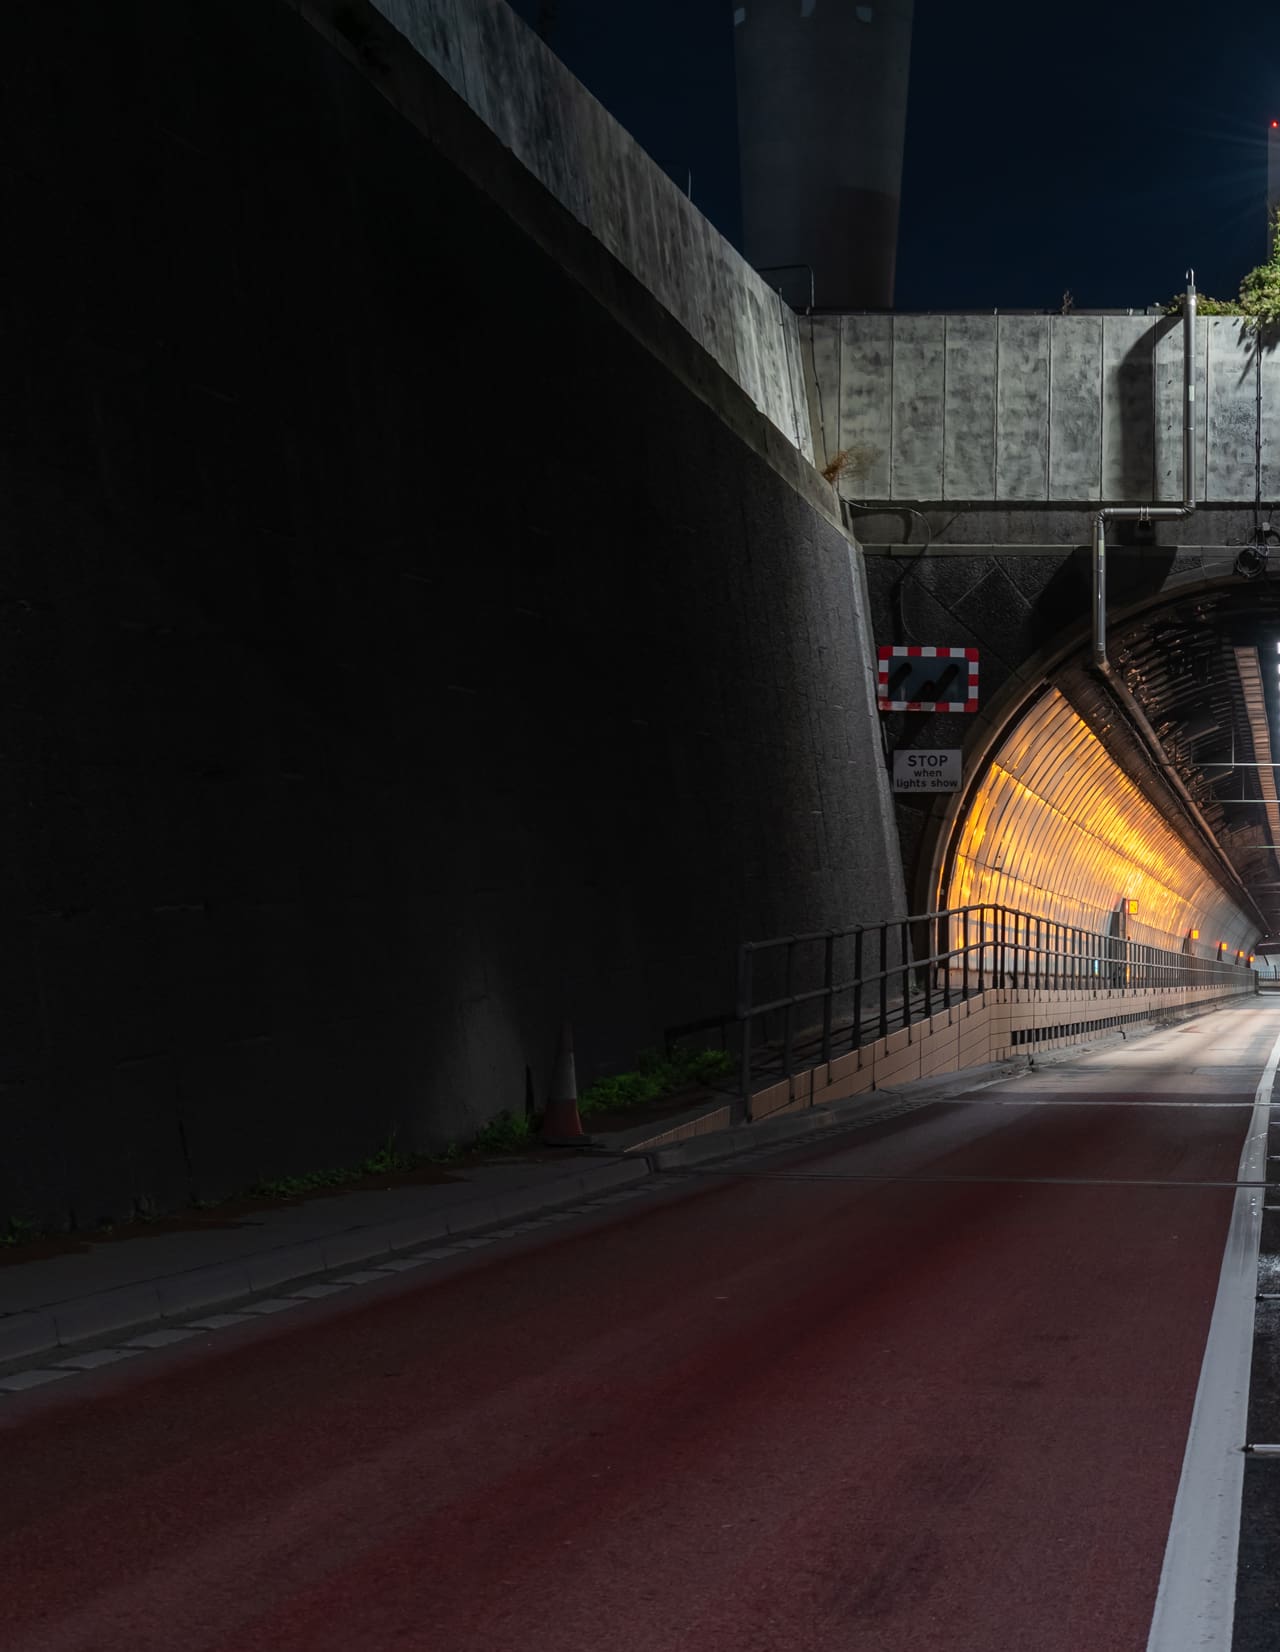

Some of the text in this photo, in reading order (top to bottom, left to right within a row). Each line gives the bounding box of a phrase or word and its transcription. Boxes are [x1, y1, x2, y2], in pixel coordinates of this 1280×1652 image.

[908, 755, 948, 767] STOP
[914, 768, 942, 777] when
[897, 778, 958, 789] lights show
